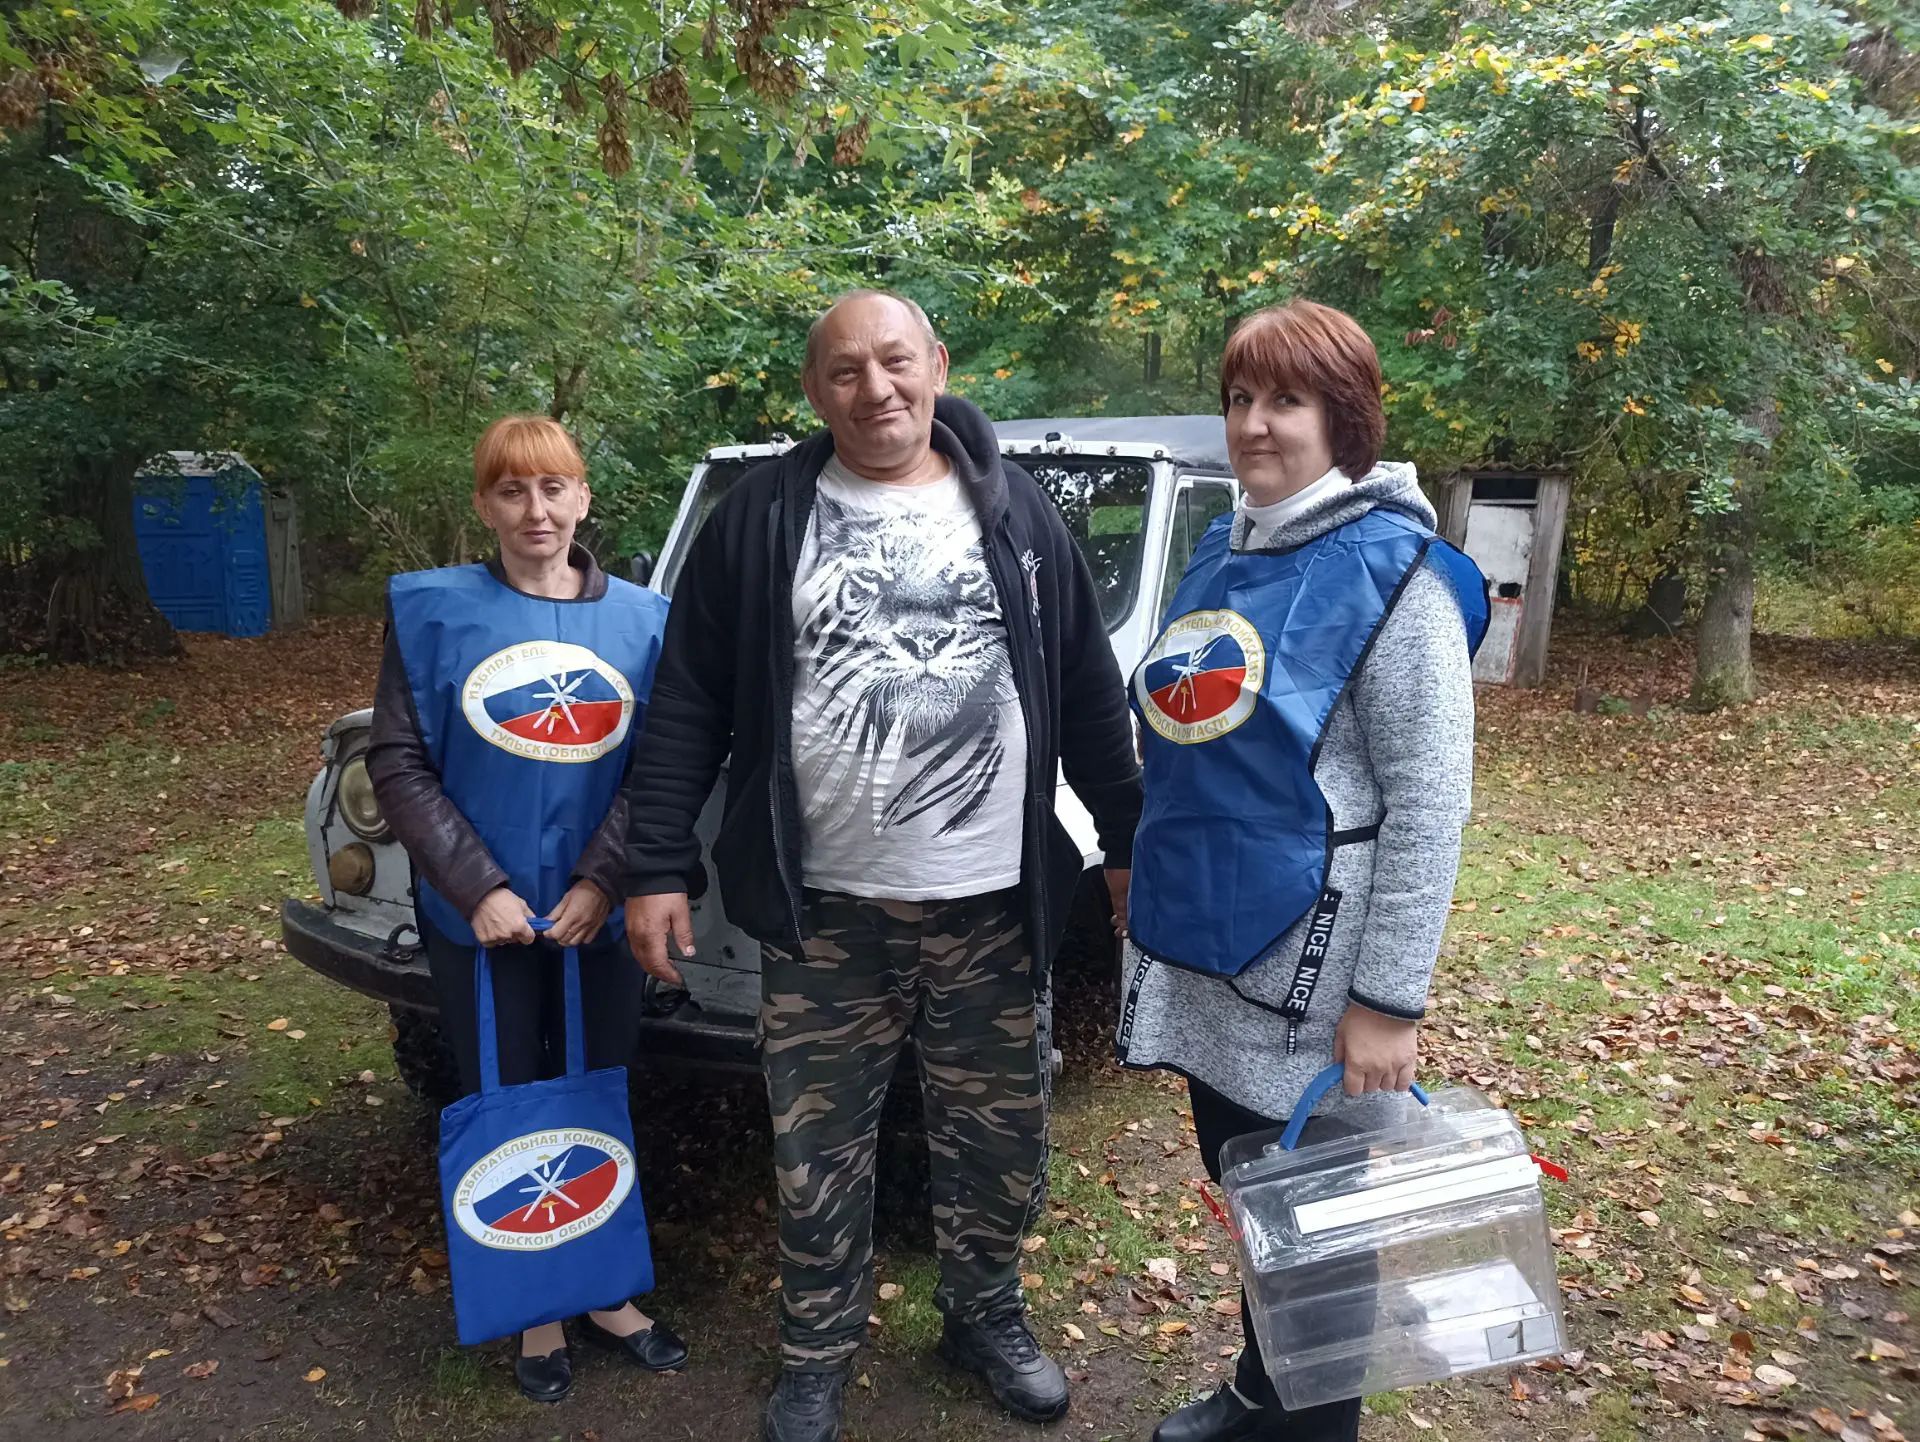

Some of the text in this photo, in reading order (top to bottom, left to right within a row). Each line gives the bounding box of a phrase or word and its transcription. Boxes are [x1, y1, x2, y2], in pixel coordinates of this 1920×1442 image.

[1304, 912, 1334, 958] NICE
[1287, 966, 1318, 1012] NICE
[1120, 1002, 1135, 1049] NICE
[457, 1132, 630, 1207] ИЗБИРАТЕЛЬНАЯ КОМИССИЯ
[481, 1199, 616, 1247] ТУЛЬСКОЙ ОБЛАСТИ
[1506, 1320, 1527, 1354] 1
